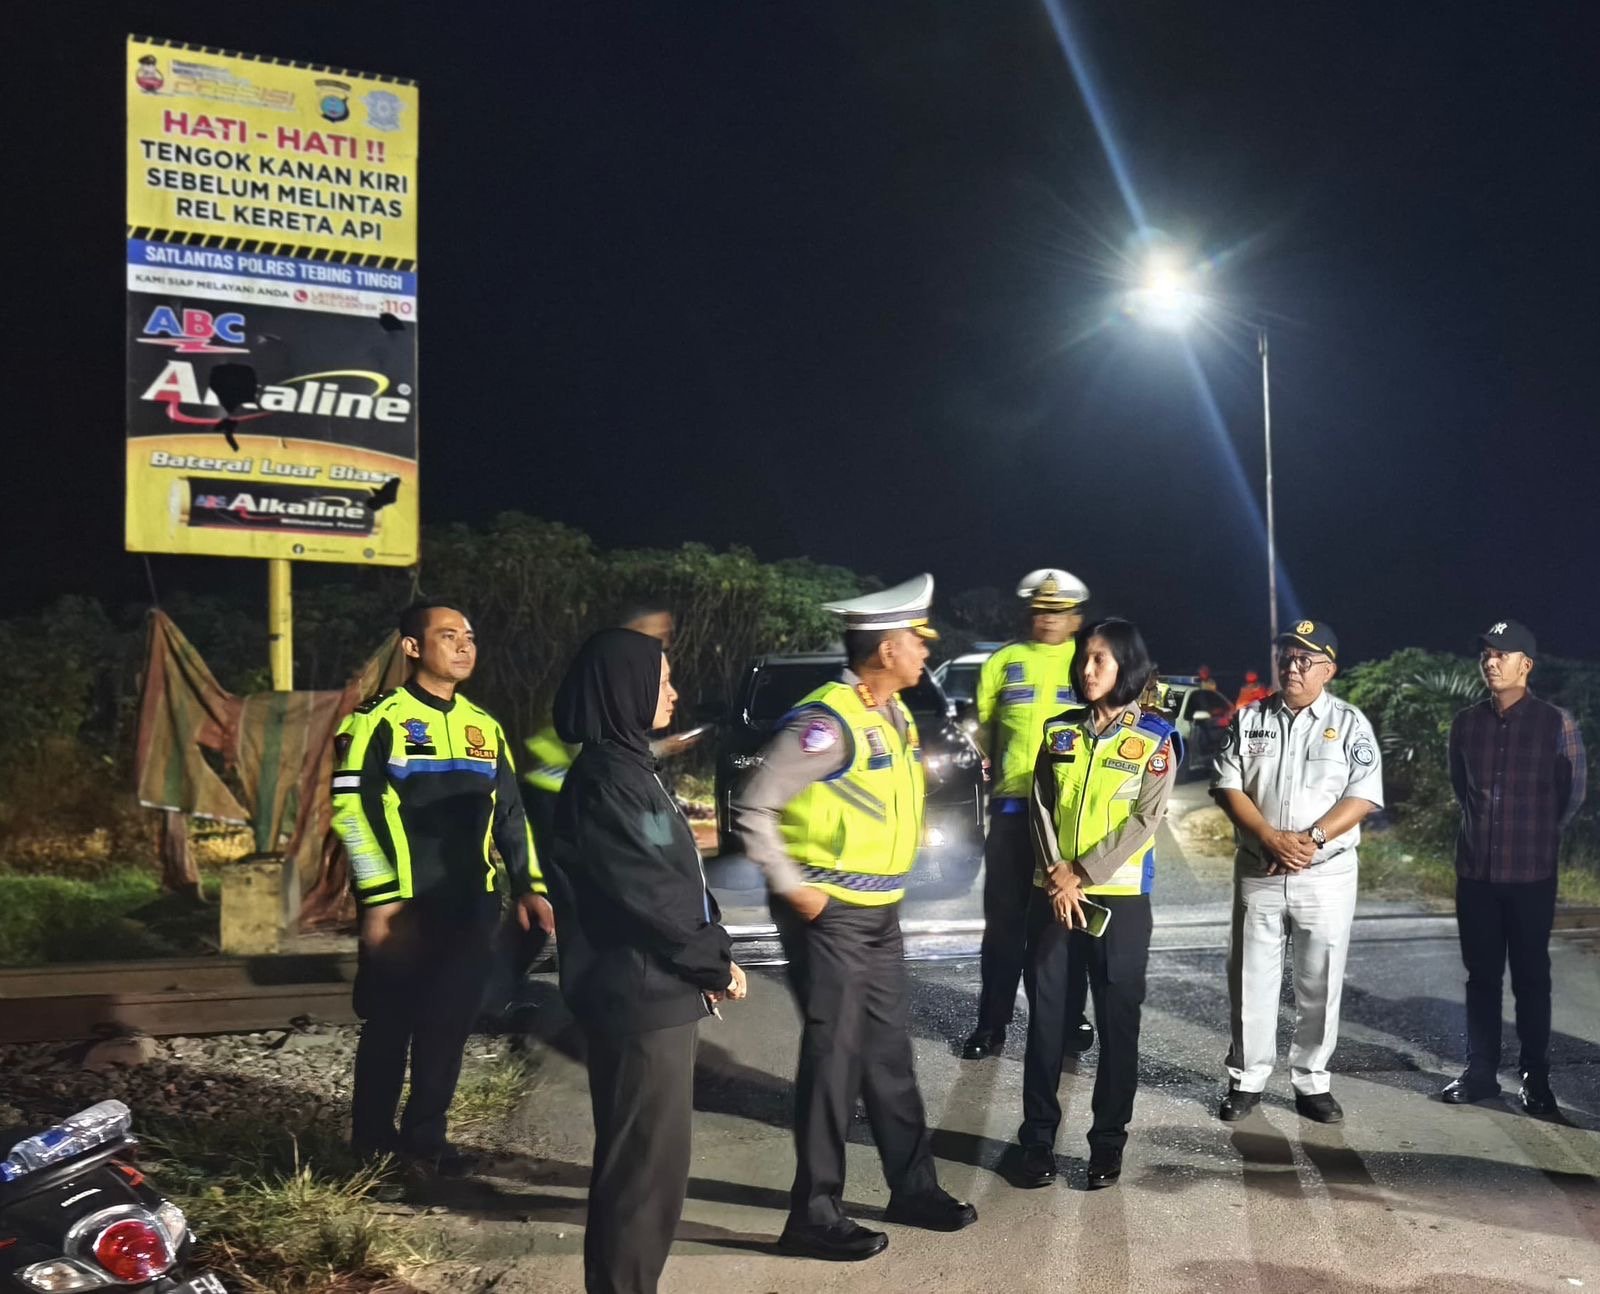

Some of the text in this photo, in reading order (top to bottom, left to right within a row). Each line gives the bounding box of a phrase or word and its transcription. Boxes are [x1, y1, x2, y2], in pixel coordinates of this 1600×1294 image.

[163, 110, 247, 143] HATI
[277, 126, 357, 158] HATI
[366, 141, 386, 163] !!
[140, 139, 408, 194] TENGOK KANAN KIRI
[147, 168, 403, 218] SEBELUM MELINTAS
[176, 199, 382, 241] REL KERETA API
[135, 274, 290, 298] KAMI SIAP MELAYANI ANDA
[145, 245, 404, 291] SATLANTAS POLRES TEBING TINGGI
[143, 304, 246, 344] ABC
[140, 360, 412, 424] Aaline
[149, 450, 253, 474] Baterai
[259, 459, 322, 479] Luar
[228, 493, 366, 520] Alkaline
[469, 748, 493, 758] POLRI
[1243, 729, 1278, 740] TENGKU
[1107, 759, 1139, 774] POLRI
